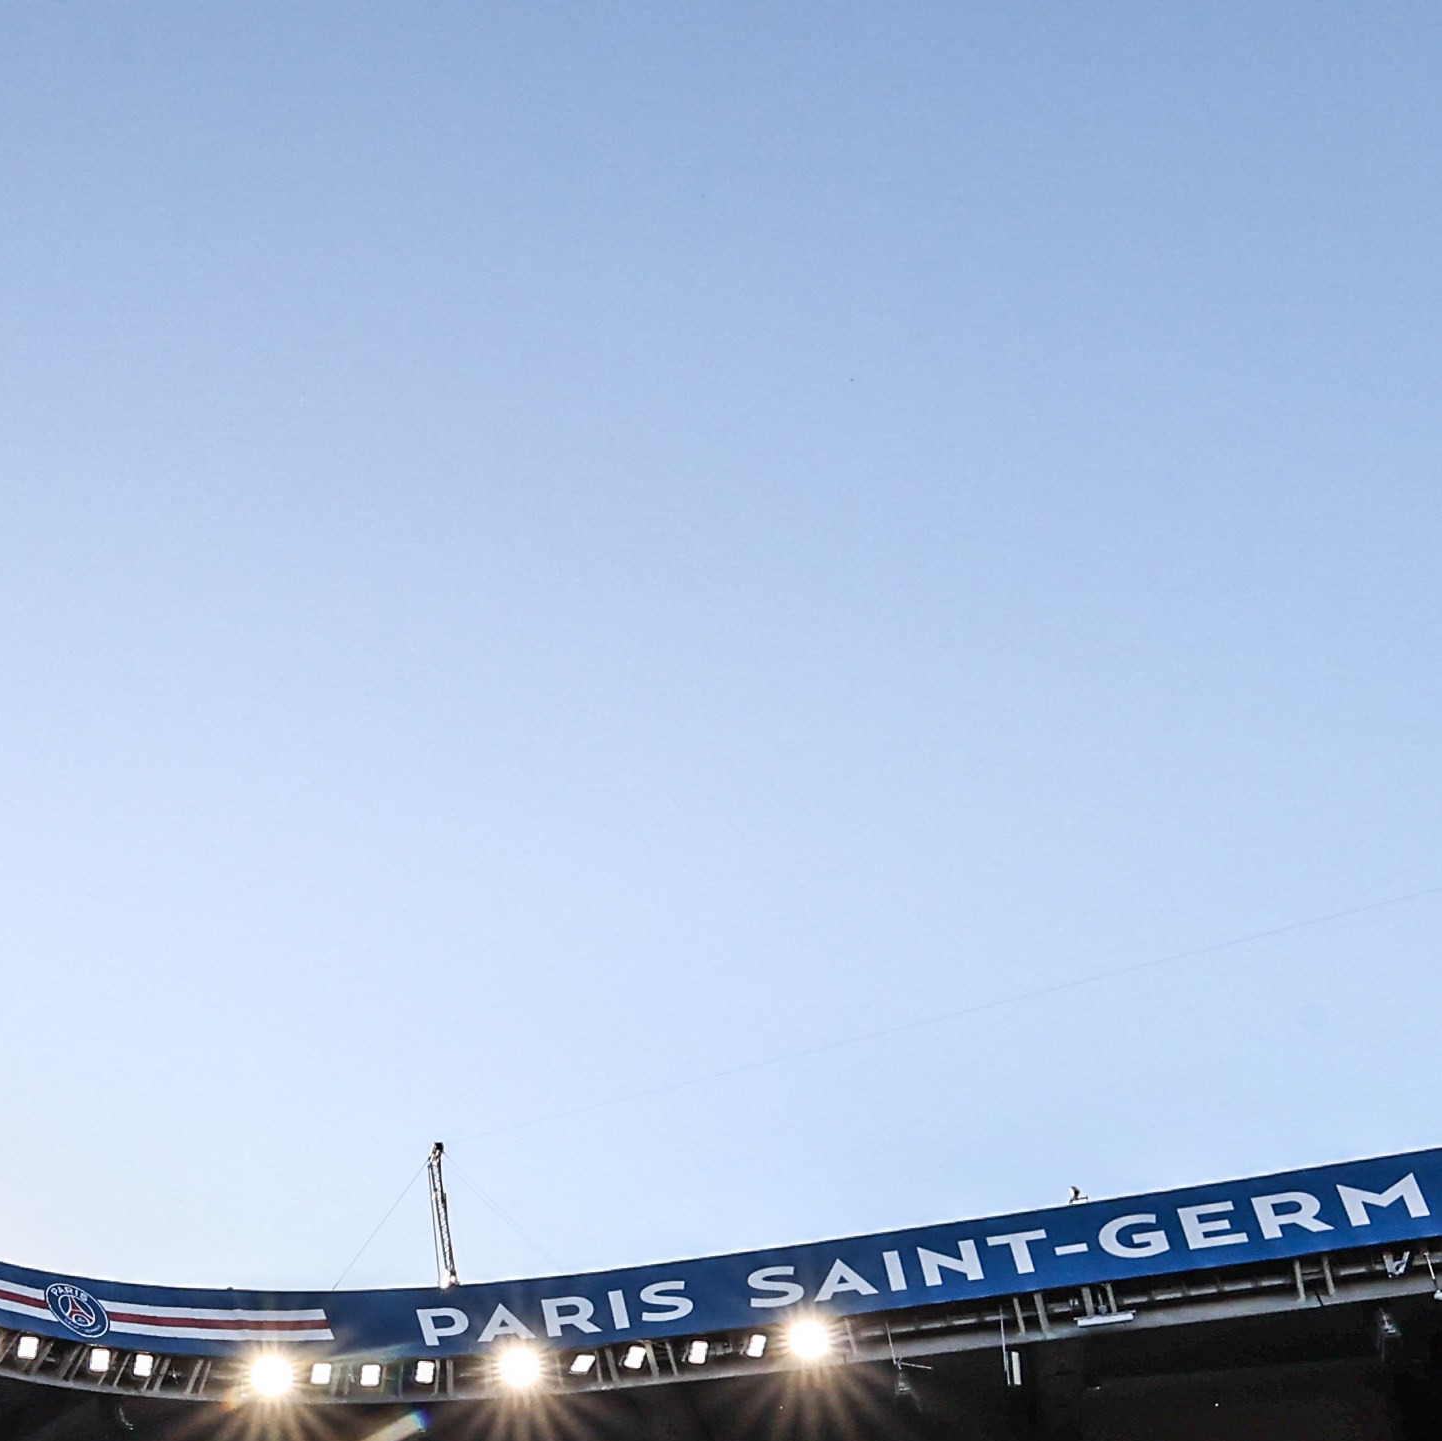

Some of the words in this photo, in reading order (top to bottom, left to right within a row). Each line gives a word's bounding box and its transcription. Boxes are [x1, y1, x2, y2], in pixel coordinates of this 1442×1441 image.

[51, 1286, 88, 1301] PARIS
[415, 1280, 695, 1347] PARIS
[748, 1172, 1431, 1309] SAINT-GERM
